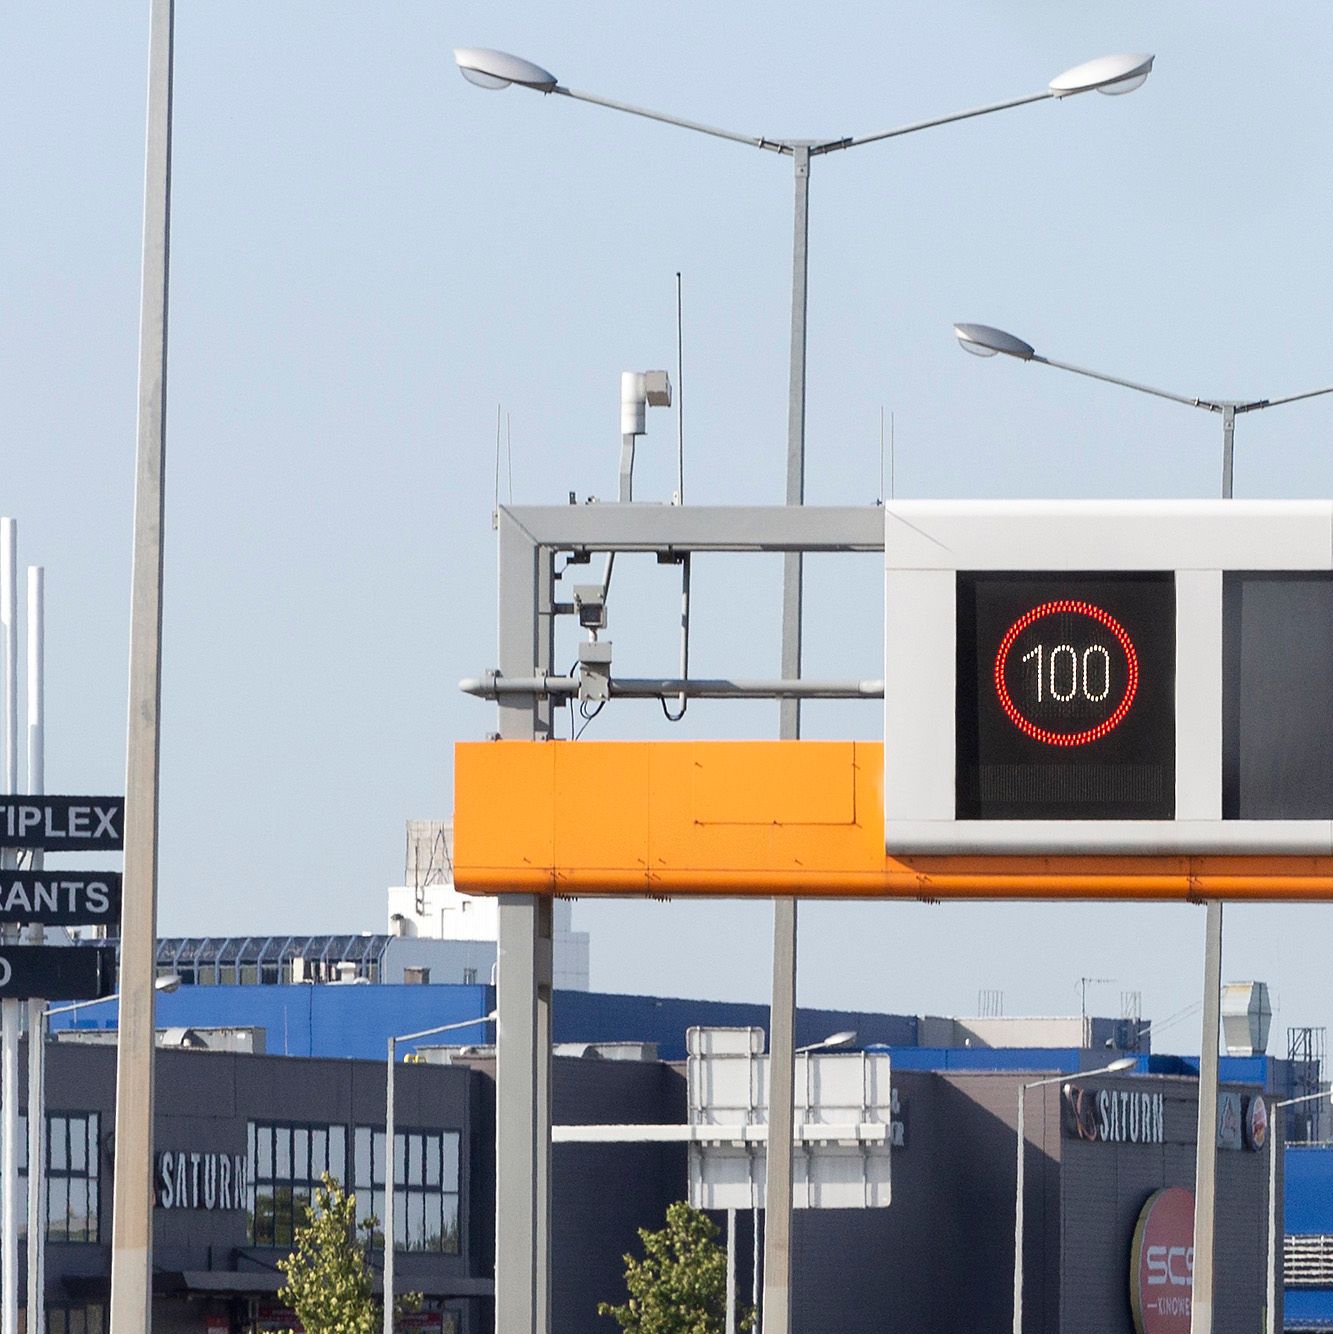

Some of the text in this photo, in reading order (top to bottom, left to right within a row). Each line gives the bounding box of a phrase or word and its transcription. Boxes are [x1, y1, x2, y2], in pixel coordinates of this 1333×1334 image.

[1022, 643, 1110, 703] 100
[0, 880, 110, 914] ANTS
[1100, 1089, 1164, 1143] SATURN
[161, 1151, 248, 1209] SATURN
